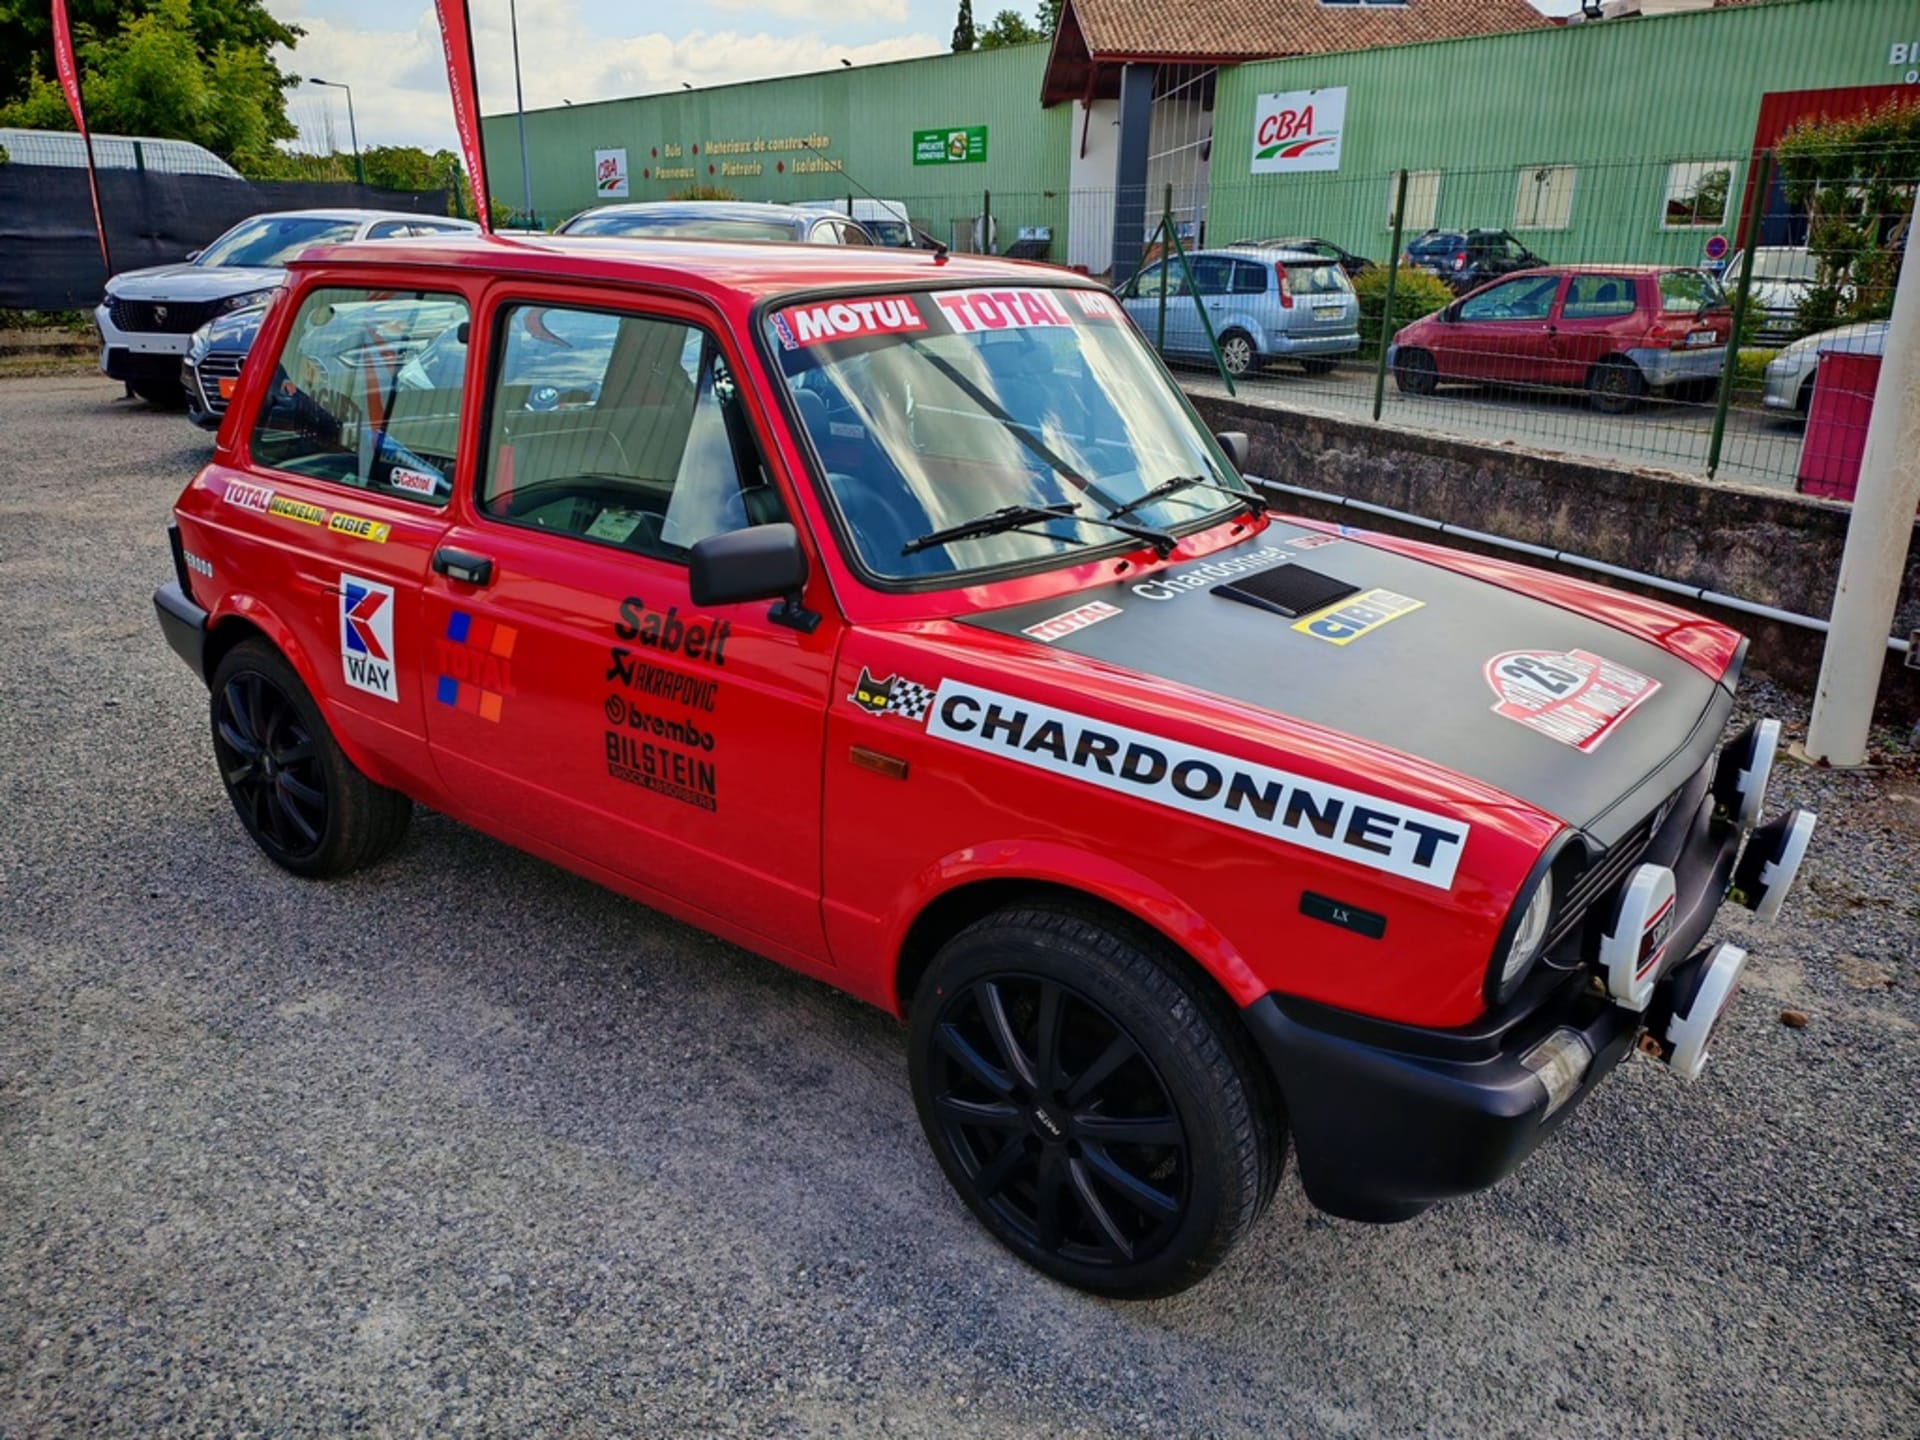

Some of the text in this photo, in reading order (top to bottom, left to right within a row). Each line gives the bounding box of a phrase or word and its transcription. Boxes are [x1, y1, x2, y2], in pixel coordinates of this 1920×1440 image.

[1258, 104, 1314, 147] CBA
[794, 299, 920, 341] MOTUL
[937, 291, 1073, 331] TOTAL
[225, 482, 268, 511] TOTAL
[401, 471, 432, 492] Castrol
[270, 498, 324, 524] MICHELIN
[1131, 546, 1297, 601] Chardonnet
[615, 596, 730, 666] Sabelt
[1027, 605, 1118, 638] TOTAL
[348, 655, 390, 692] WAY
[1502, 658, 1579, 695] 23
[629, 703, 715, 752] brembo
[606, 730, 716, 796] BILSTEIN
[940, 694, 1459, 868] CHARDONNET
[1332, 908, 1351, 923] LX
